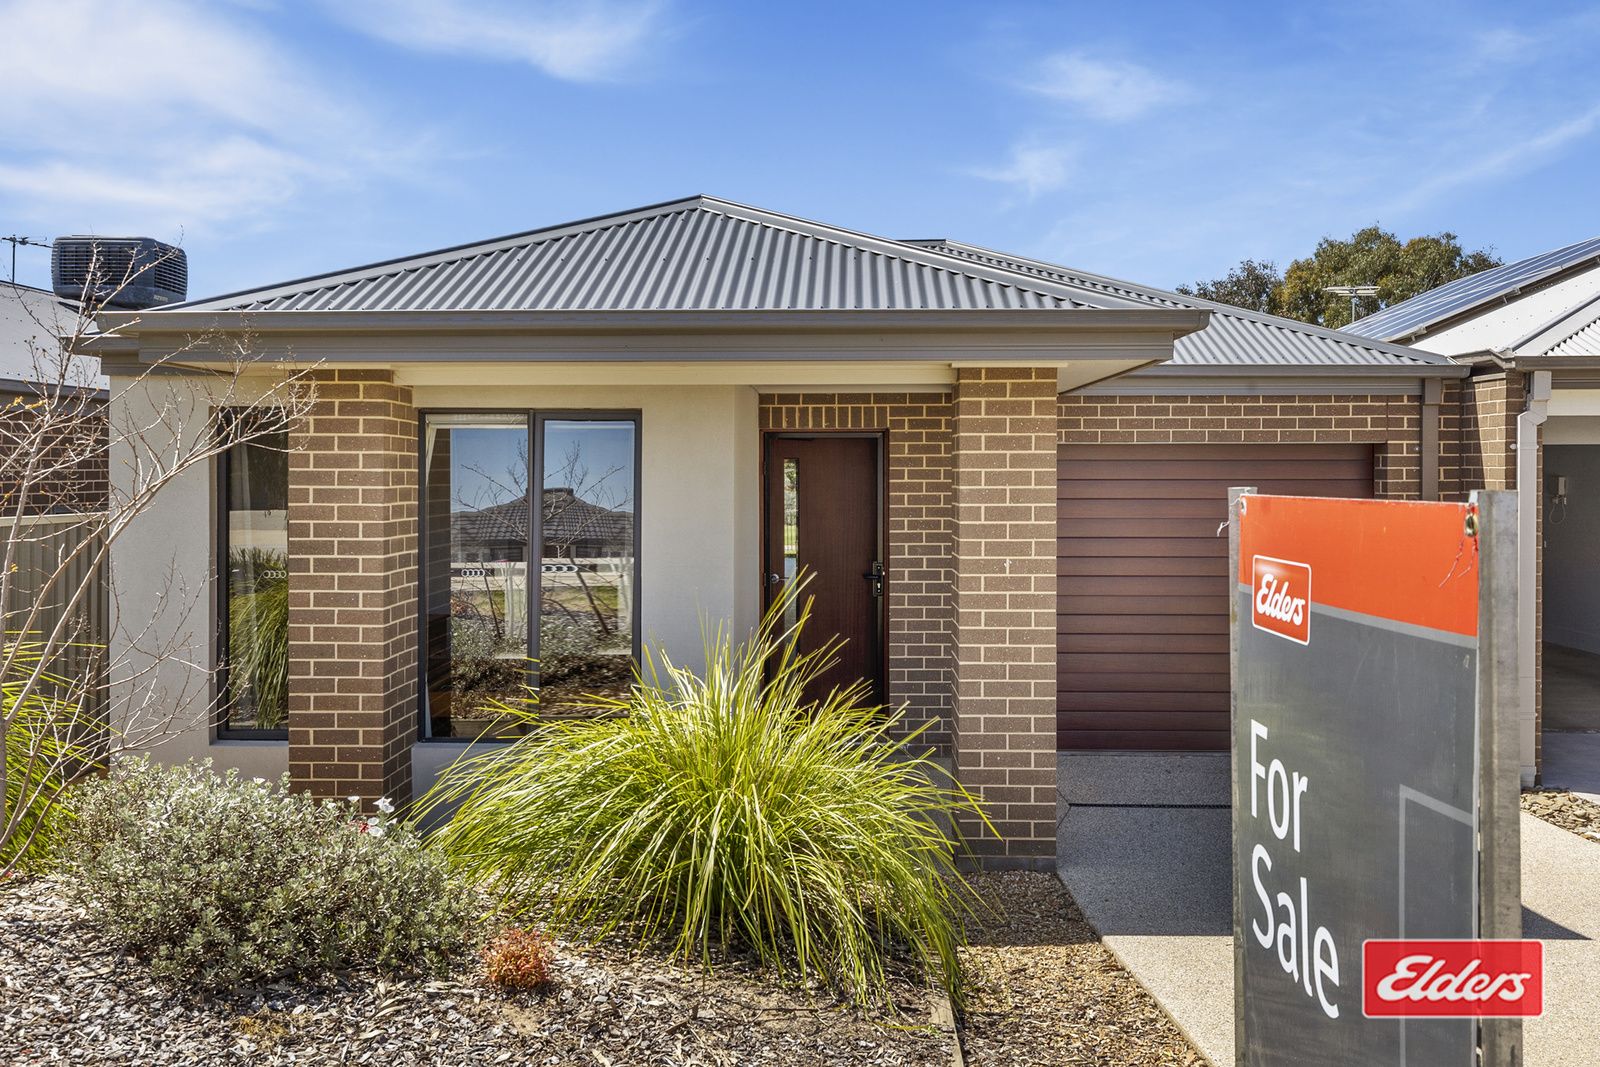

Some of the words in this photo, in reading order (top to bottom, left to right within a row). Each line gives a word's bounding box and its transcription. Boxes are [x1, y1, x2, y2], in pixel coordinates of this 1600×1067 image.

[1256, 573, 1306, 626] Elders
[1251, 718, 1308, 853] For
[1252, 843, 1340, 1019] Sale
